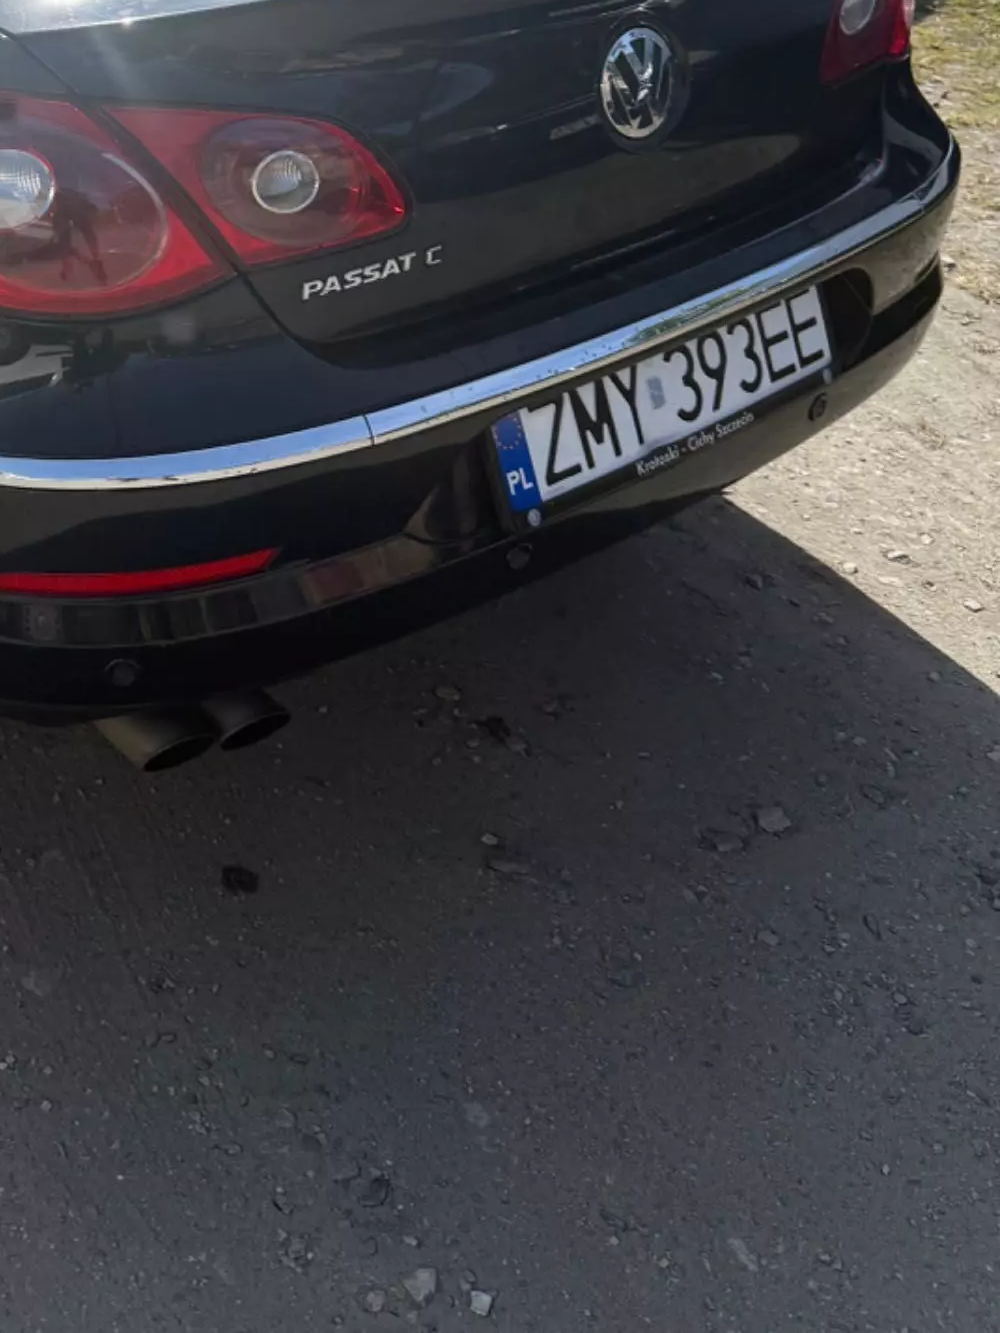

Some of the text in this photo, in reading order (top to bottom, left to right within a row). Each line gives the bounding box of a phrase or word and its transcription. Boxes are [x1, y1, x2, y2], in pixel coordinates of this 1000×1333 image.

[301, 251, 417, 301] PASSAT
[527, 288, 825, 486] ZMY 393EE
[505, 467, 534, 496] PL
